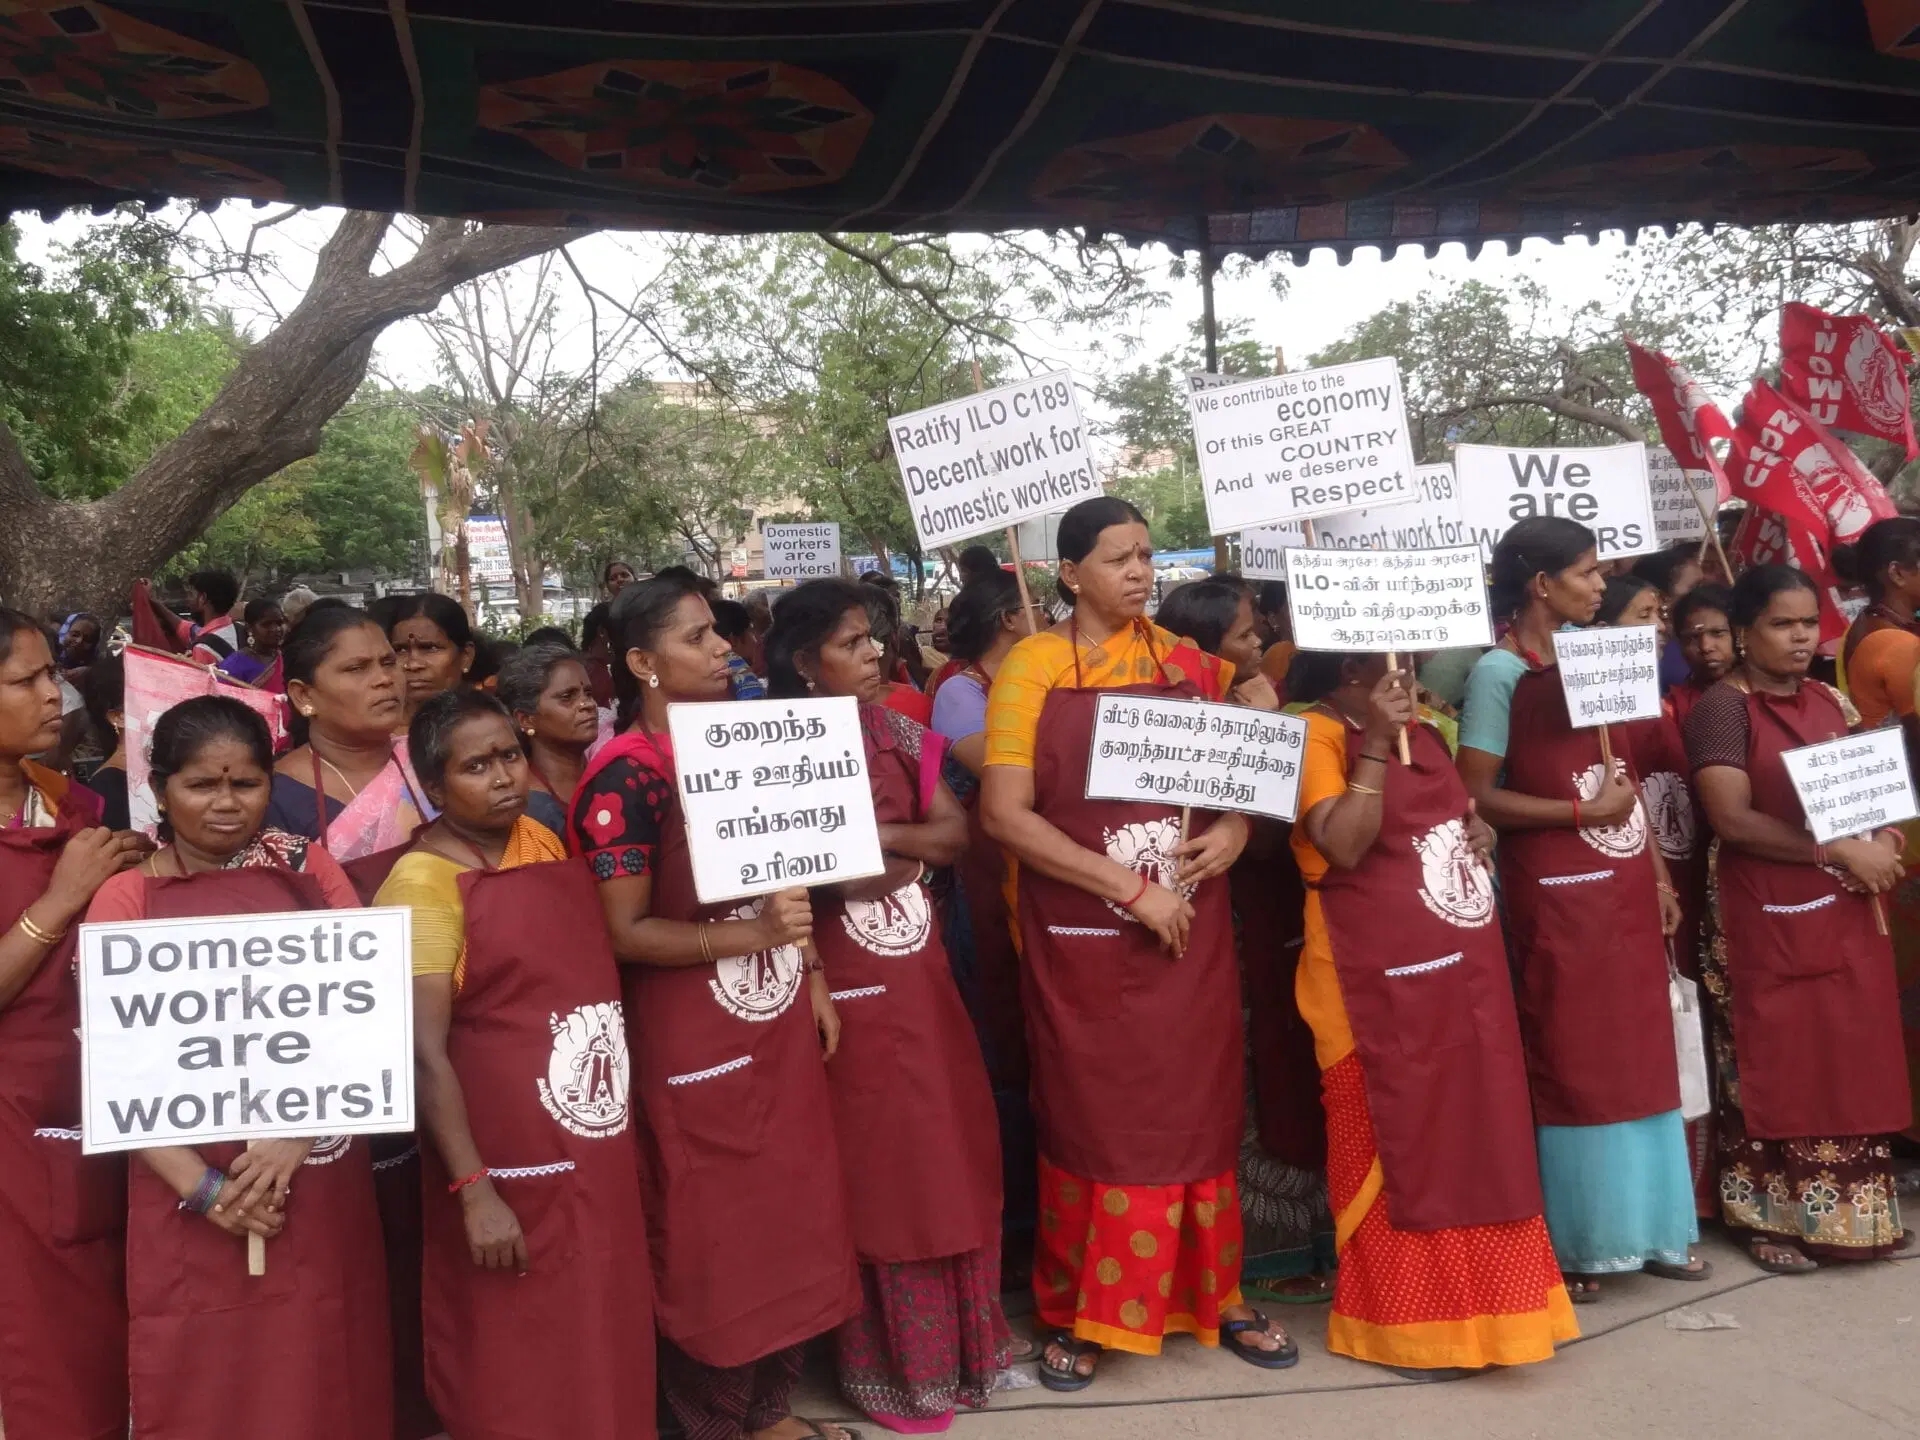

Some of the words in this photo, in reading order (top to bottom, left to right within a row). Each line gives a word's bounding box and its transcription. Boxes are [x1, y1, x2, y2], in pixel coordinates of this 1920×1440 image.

[1195, 396, 1218, 414] We
[1223, 381, 1298, 407] contribute
[1302, 378, 1317, 392] to
[1322, 374, 1345, 389] the
[1277, 385, 1391, 422] economy
[896, 415, 961, 453] Ratify
[967, 400, 1007, 432] ILO
[1013, 381, 1070, 418] C189
[1206, 438, 1226, 454] Of
[1231, 433, 1264, 450] this
[1269, 419, 1332, 442] GREAT
[1281, 429, 1397, 462] COUNTRY
[907, 449, 988, 496] Decent
[990, 432, 1048, 472] work
[1050, 425, 1081, 454] for
[1214, 473, 1254, 494] And
[1265, 469, 1292, 485] we
[1299, 455, 1379, 478] deserve
[1508, 453, 1591, 487] We
[920, 487, 1010, 536] domestic
[1012, 457, 1098, 510] workers!
[1291, 470, 1405, 508] Respect
[1414, 474, 1453, 503] 189
[1508, 492, 1599, 521] are
[767, 526, 831, 538] Domestic
[769, 538, 831, 550] workers
[1393, 518, 1436, 549] work
[1438, 515, 1463, 545] for
[769, 562, 836, 575] workers!
[785, 551, 816, 560] are
[1298, 600, 1357, 620] மற்றும்
[705, 709, 827, 748] குறைந்த
[1103, 704, 1140, 728] வீட்டு
[1144, 709, 1207, 736] வேலைத்
[1211, 717, 1301, 748] தொழிலுக்கு
[684, 768, 743, 794] பட்ச
[753, 750, 860, 789] ஊதியம்
[1100, 736, 1206, 764] குறைந்தபட்ச
[1208, 746, 1296, 780] ஊதியத்தை
[1135, 770, 1257, 804] அமுல்படுத்து
[716, 805, 847, 839] எங்களது
[740, 851, 838, 886] உரிமை
[101, 922, 378, 976] Domestic
[111, 975, 375, 1029] workers
[177, 1031, 311, 1070] are
[107, 1069, 393, 1134] workers!
